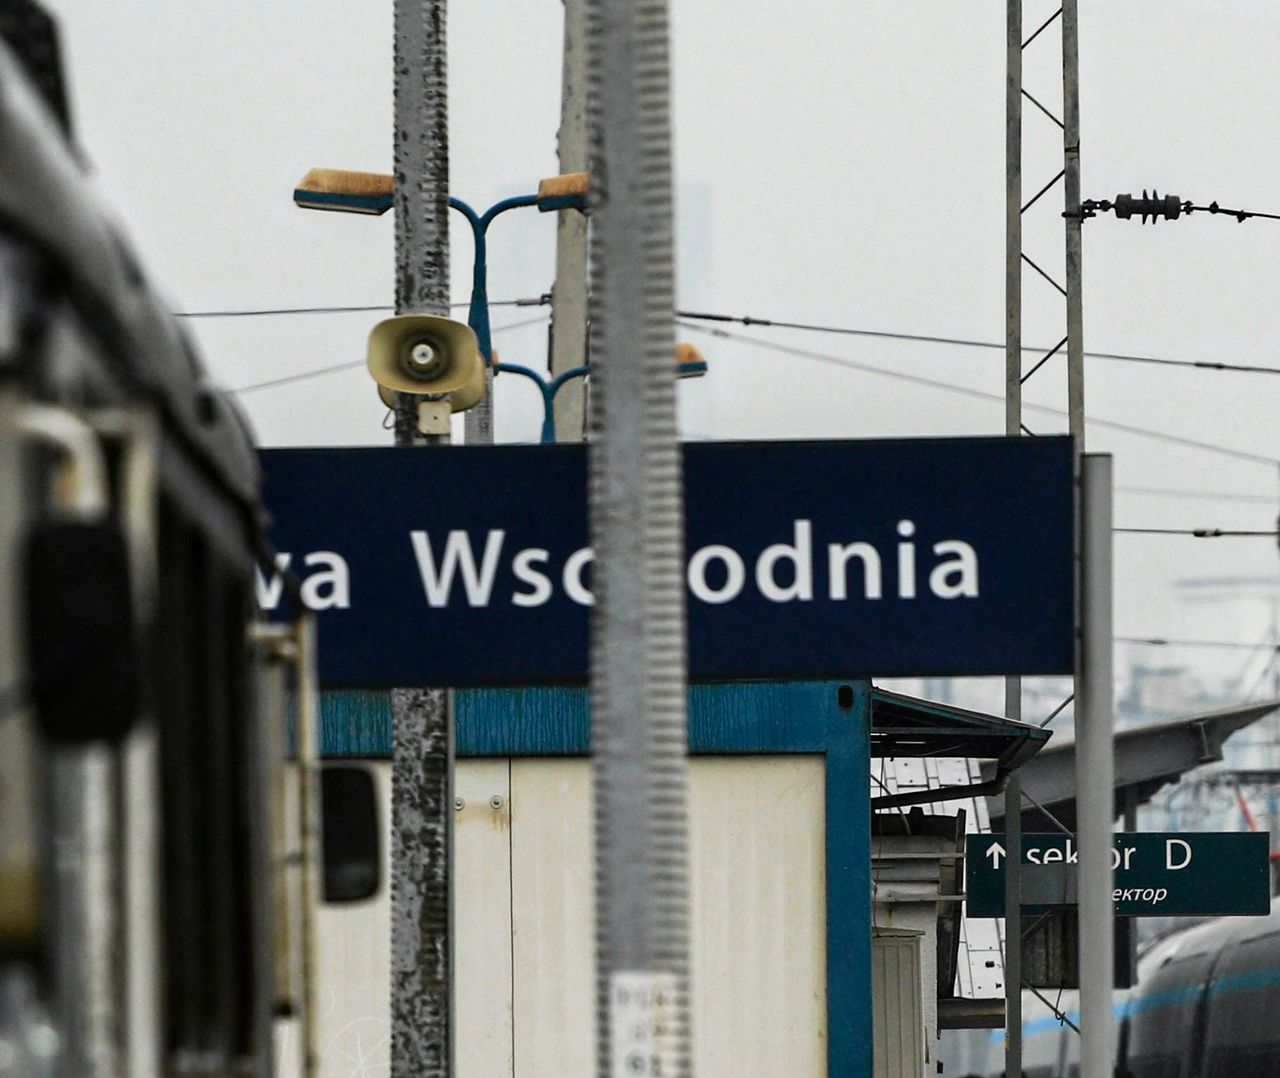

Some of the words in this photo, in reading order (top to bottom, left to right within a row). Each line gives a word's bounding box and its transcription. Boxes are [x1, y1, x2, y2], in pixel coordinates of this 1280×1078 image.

[410, 520, 980, 608] Wscodnia
[1026, 839, 1136, 870] sekor
[1166, 839, 1192, 870] D
[1111, 888, 1168, 905] ектор
